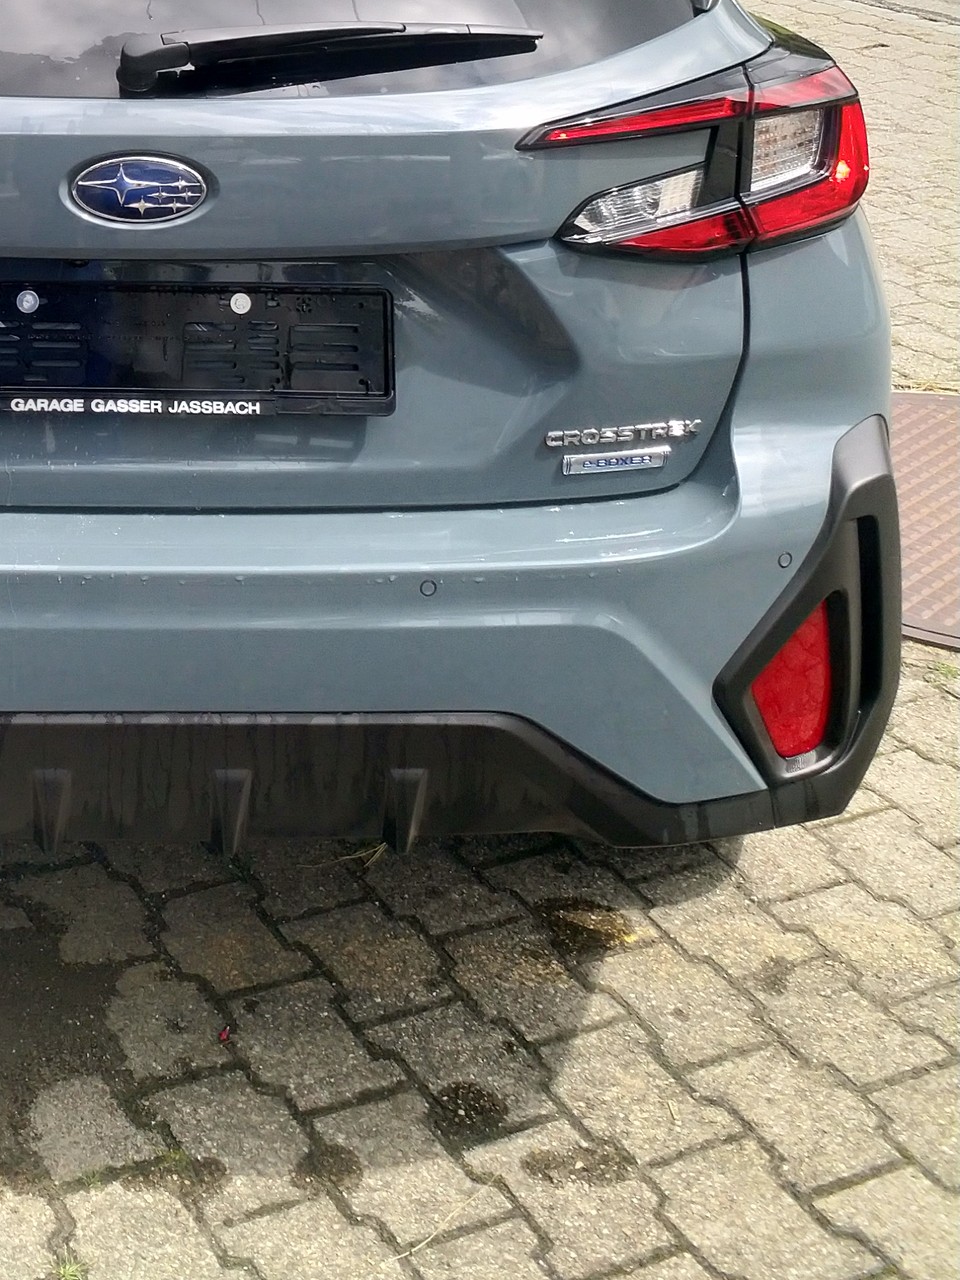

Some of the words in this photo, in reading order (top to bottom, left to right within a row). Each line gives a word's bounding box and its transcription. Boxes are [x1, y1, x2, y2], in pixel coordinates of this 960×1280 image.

[10, 399, 84, 412] GARAGE
[90, 399, 162, 413] GASSER
[168, 400, 261, 415] JASSBACH
[545, 419, 702, 447] CROSSTREK
